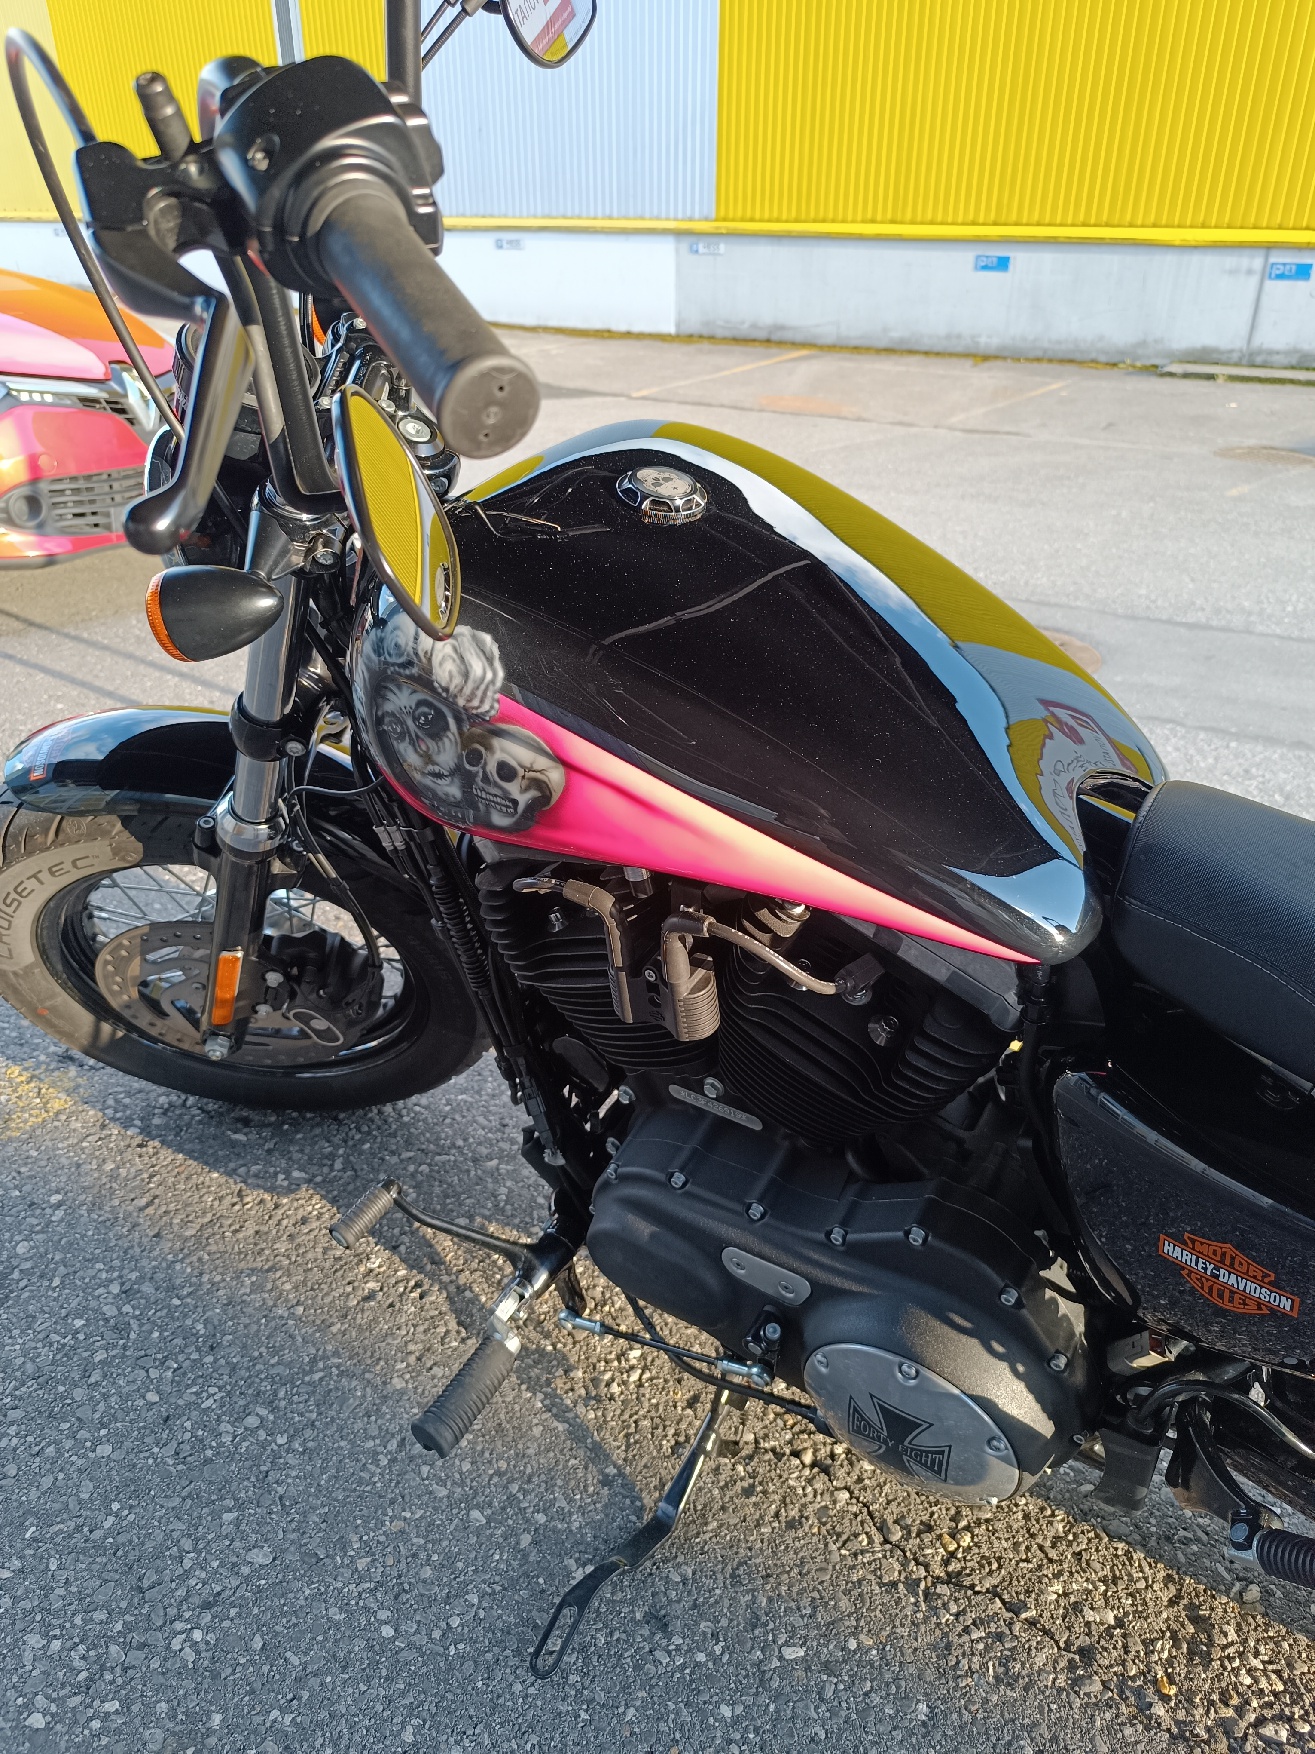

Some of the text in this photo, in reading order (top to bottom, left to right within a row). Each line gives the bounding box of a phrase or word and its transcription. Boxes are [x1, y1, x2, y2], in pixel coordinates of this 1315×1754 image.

[1163, 1240, 1292, 1311] HARLEY-DAVIDSON
[1194, 1241, 1263, 1280] MOTOR
[1190, 1273, 1258, 1310] CYCLES
[853, 1412, 943, 1471] FORTY EIGHT
